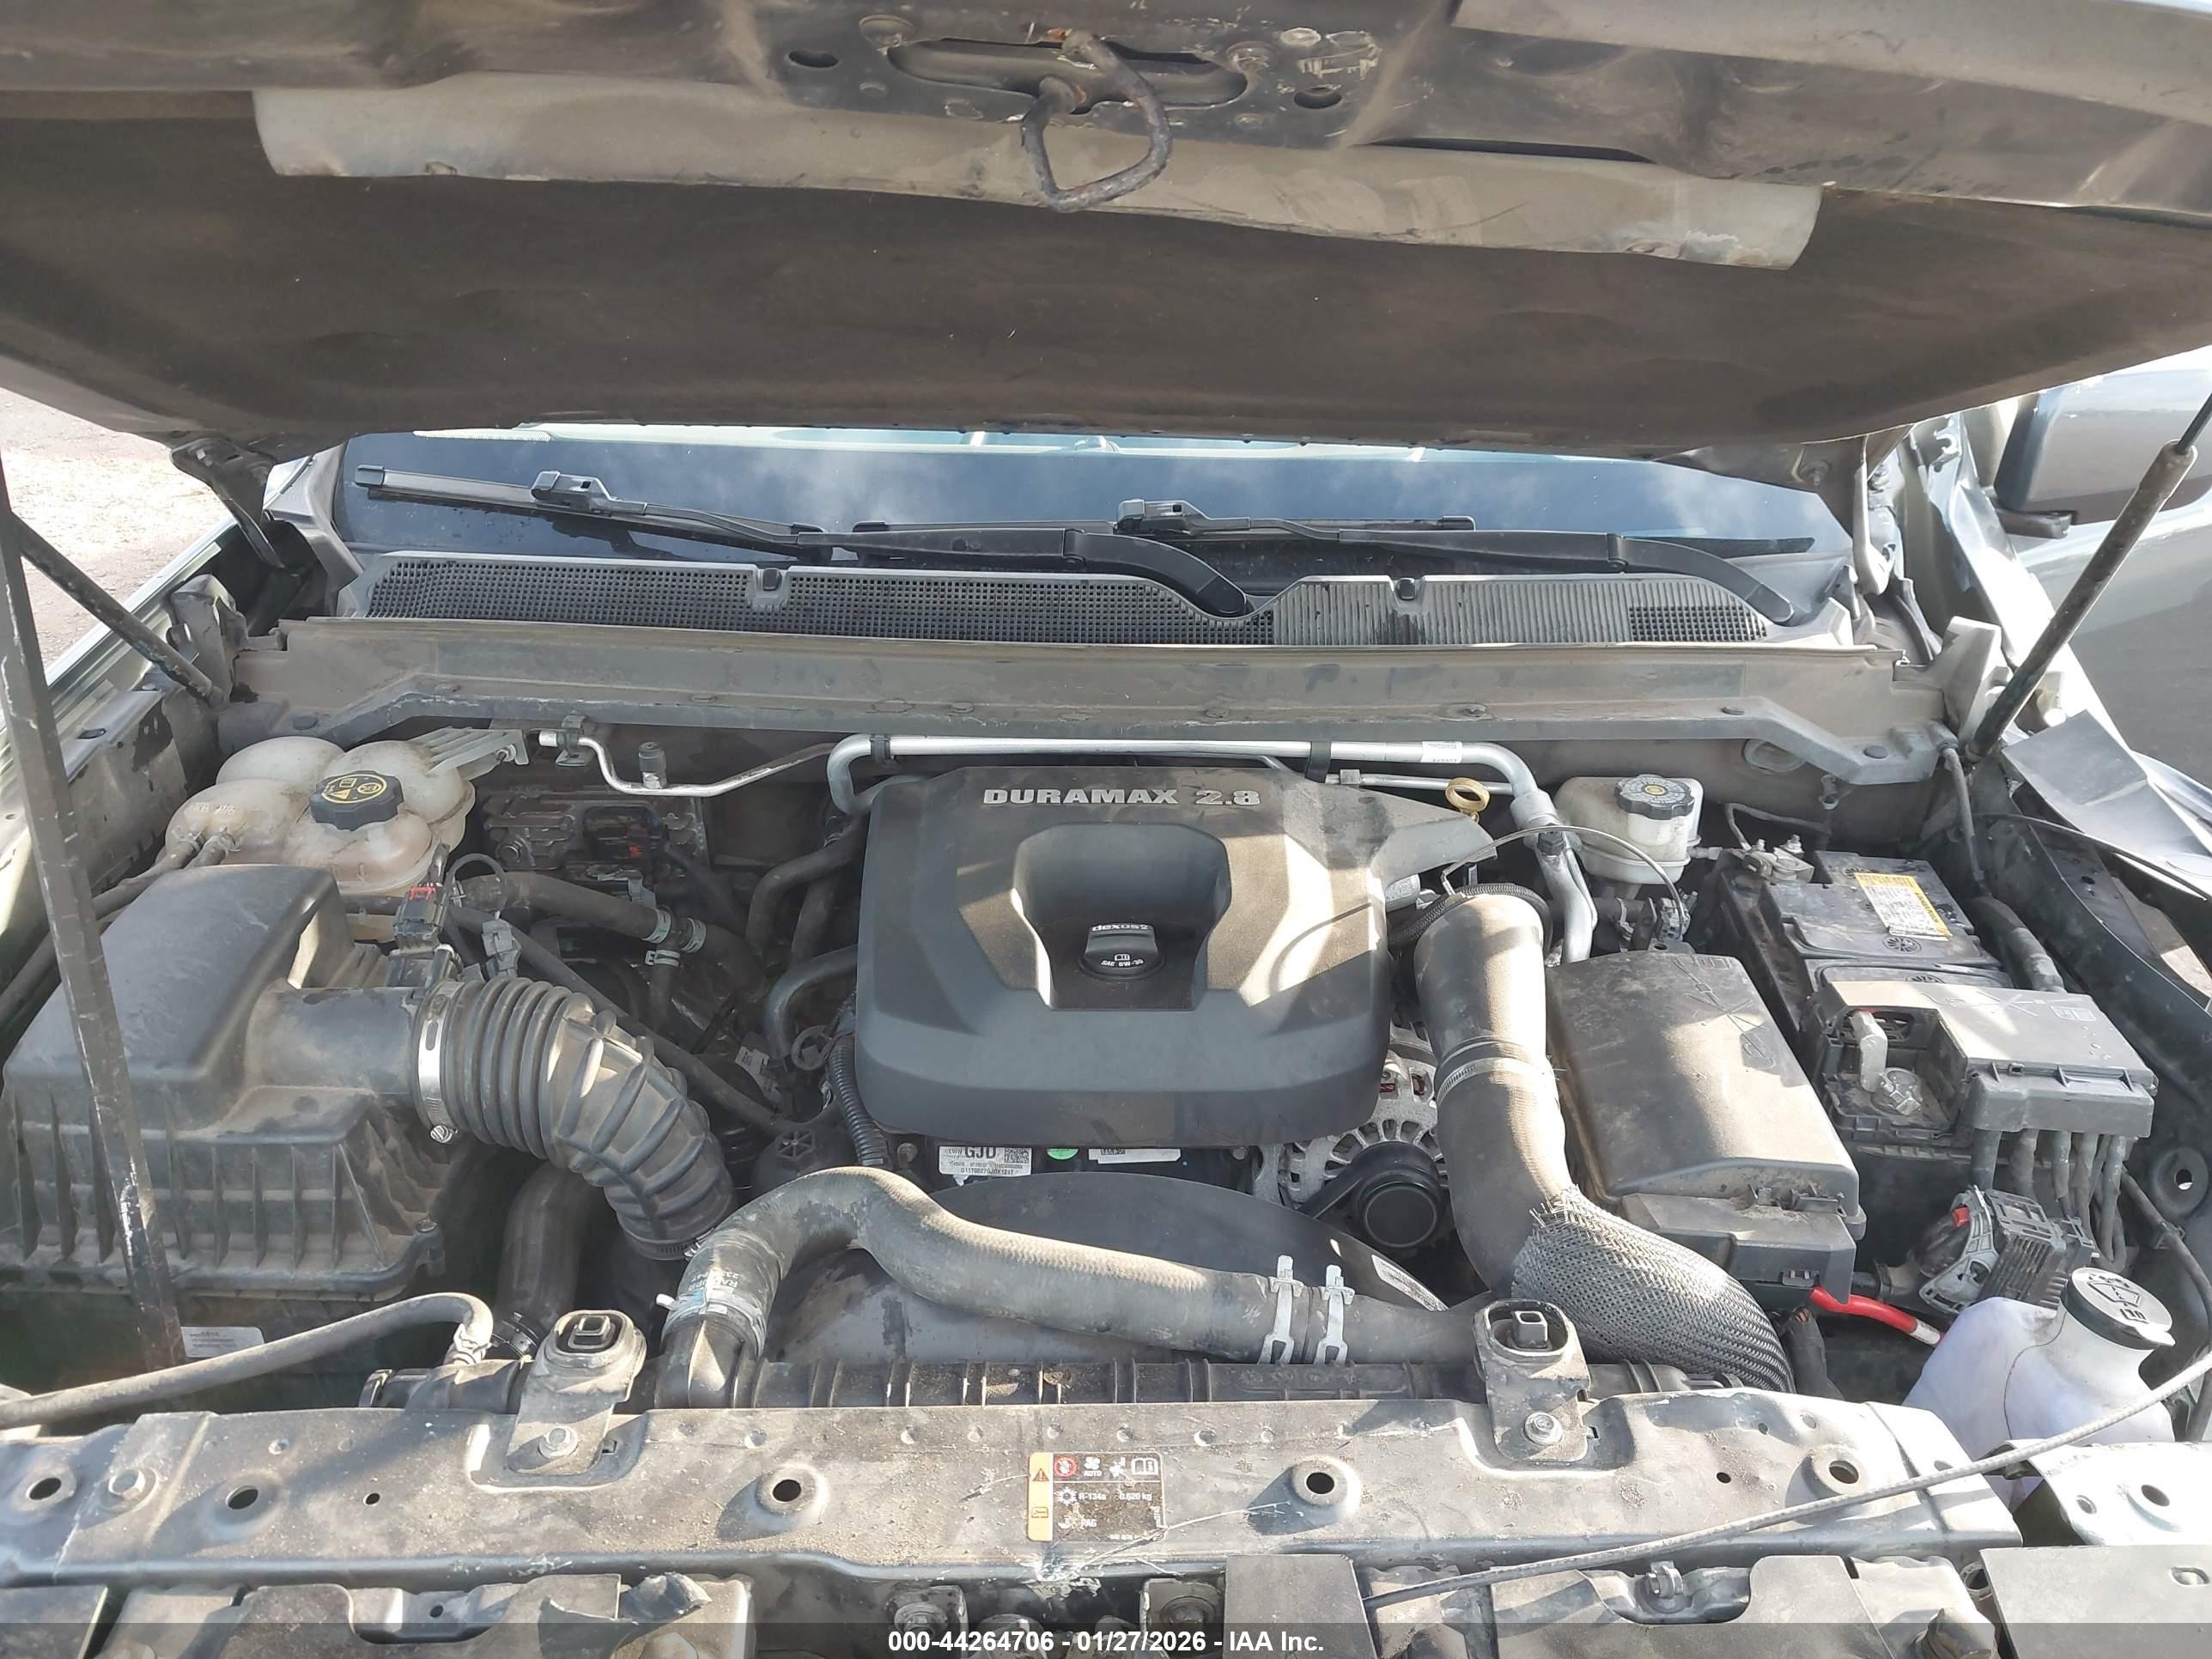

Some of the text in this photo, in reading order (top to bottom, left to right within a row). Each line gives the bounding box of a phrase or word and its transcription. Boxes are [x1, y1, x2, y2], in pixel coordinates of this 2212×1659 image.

[983, 788, 1261, 805] DURAMAX 2.8
[964, 1147, 997, 1159] GJD
[1079, 1492, 1107, 1501] R-134a
[1142, 1492, 1152, 1502] kg
